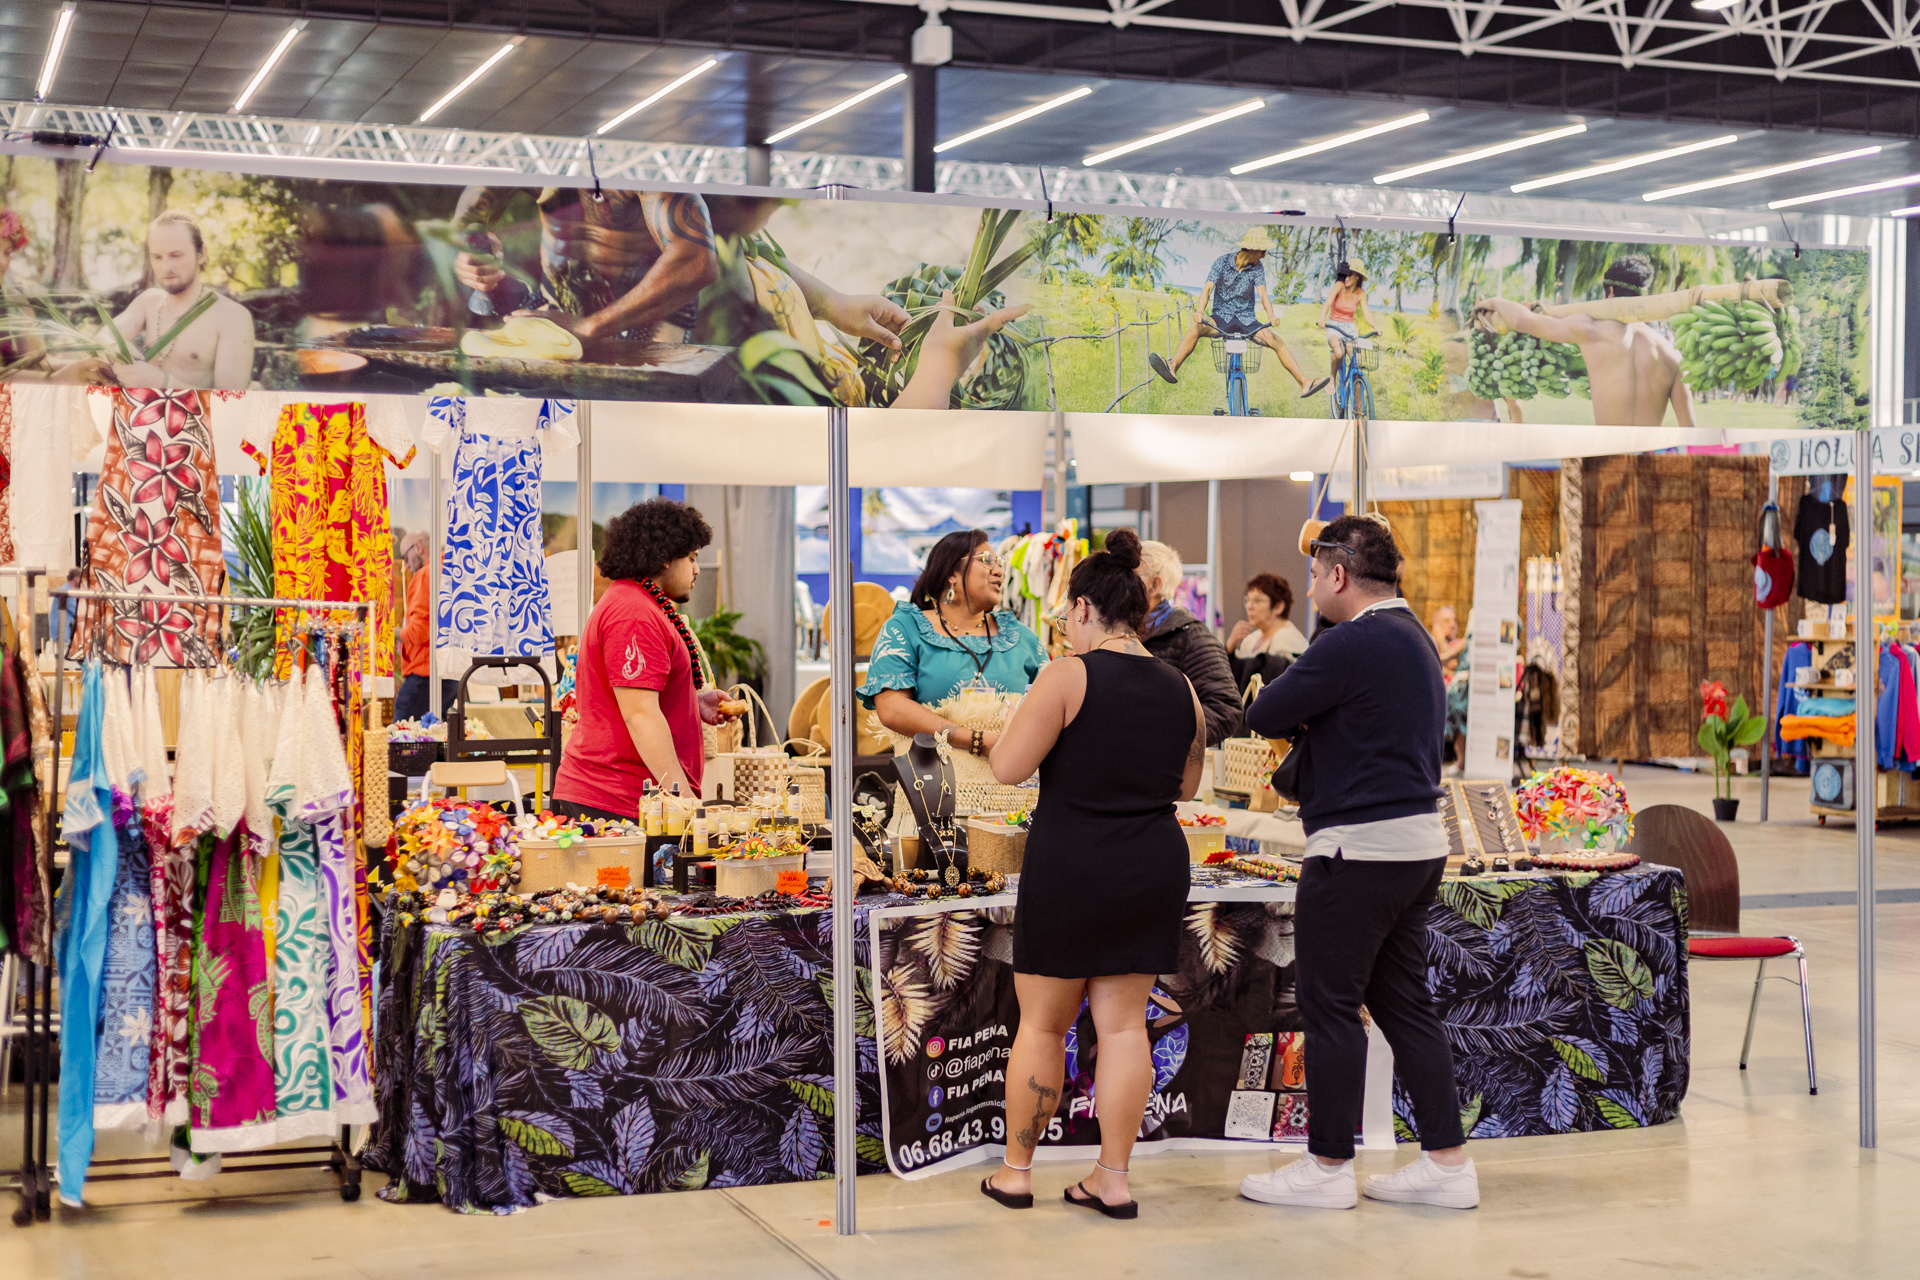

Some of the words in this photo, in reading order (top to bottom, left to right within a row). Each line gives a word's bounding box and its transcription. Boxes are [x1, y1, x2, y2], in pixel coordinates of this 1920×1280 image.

[1799, 434, 1884, 468] HOLA
[948, 1036, 972, 1051] FIA
[974, 1024, 1009, 1044] PENA
[945, 1046, 1011, 1078] @fiapena
[947, 1083, 970, 1100] FIA
[971, 1069, 1005, 1092] PENA
[944, 1099, 1007, 1124] fiapena.loganmusic@
[1069, 1096, 1098, 1119] FI
[1143, 1091, 1188, 1116] ENA
